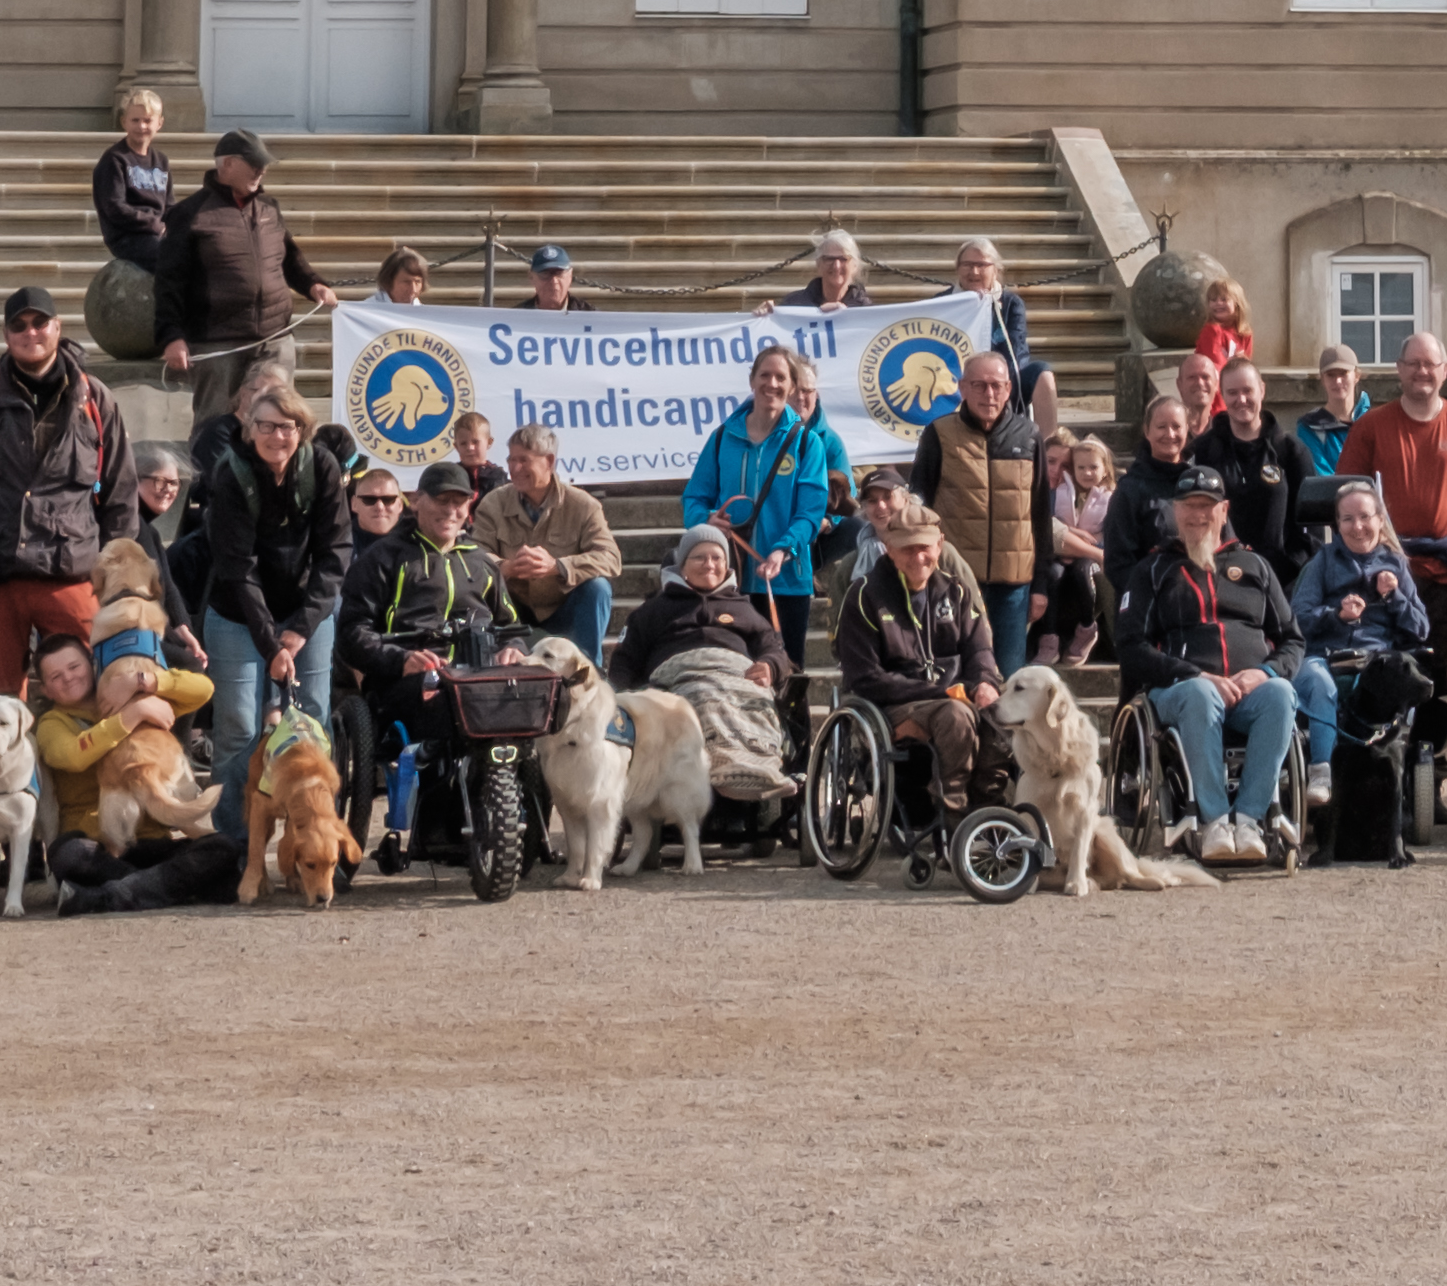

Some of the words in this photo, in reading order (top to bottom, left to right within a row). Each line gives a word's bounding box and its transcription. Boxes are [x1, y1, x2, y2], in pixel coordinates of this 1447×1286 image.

[793, 319, 838, 360] til
[350, 338, 392, 450] SERVICEHUNDE
[396, 333, 417, 347] TIL
[422, 336, 471, 449] HANDICAPDE
[862, 329, 900, 432] SERVICEHUNDE
[901, 321, 924, 336] TIL
[395, 447, 427, 463] STH
[555, 447, 700, 474] w.service
